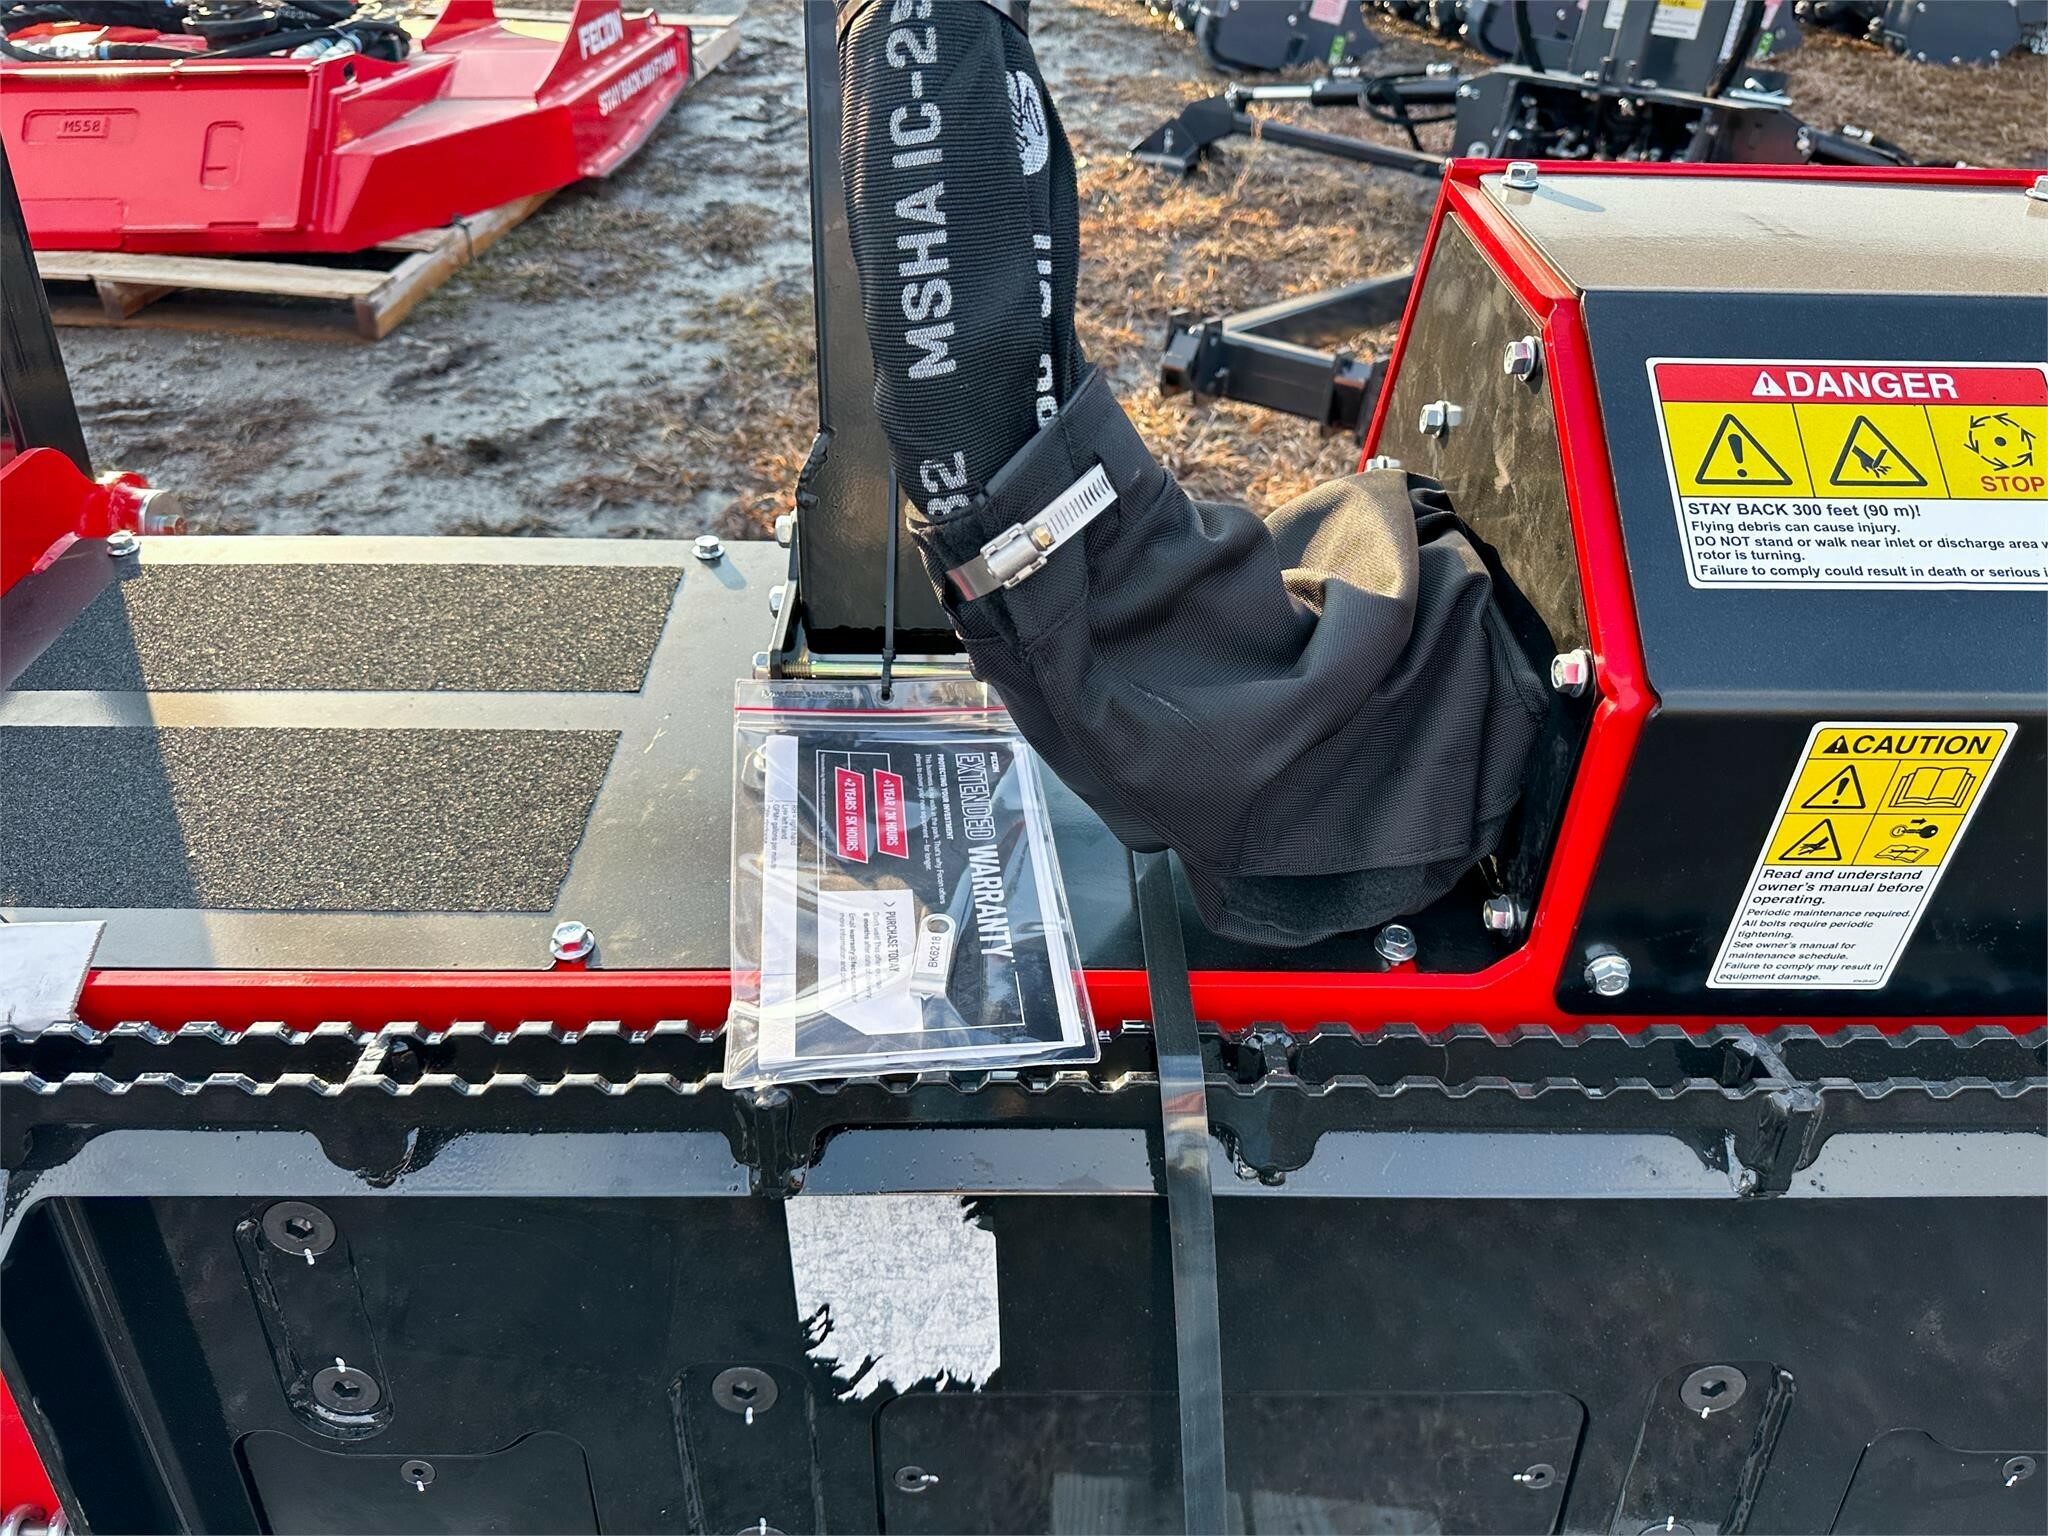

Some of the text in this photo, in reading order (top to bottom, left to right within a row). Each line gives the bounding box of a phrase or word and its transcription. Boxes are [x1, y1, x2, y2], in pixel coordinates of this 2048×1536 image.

[578, 9, 624, 60] FECON
[63, 119, 101, 133] M558
[895, 181, 957, 381] MSHA
[1785, 370, 1959, 399] DANGER
[1980, 475, 2045, 492] STOP
[1688, 502, 1921, 520] STAY BACK 300 feet (90 m)!
[1691, 520, 1901, 535] Flying debris can cause injury.
[1695, 535, 1716, 547] DO
[1721, 535, 1750, 547] NOT
[1755, 536, 1793, 547] stand
[1797, 539, 1812, 547] or
[1815, 536, 1847, 547] walk
[1851, 539, 1881, 548] near
[1884, 536, 1915, 549] inlet
[1919, 539, 1933, 549] or
[1937, 537, 2005, 551] discharge
[2009, 540, 2039, 549] area
[1697, 550, 1806, 563] rotor is turning.
[1701, 565, 1749, 576] Failure
[1752, 566, 1766, 576] to
[1769, 565, 1821, 579] comply
[1824, 566, 1863, 577] could
[1867, 566, 1907, 577] result
[1910, 566, 1924, 577] in
[1928, 566, 1966, 578] death
[1970, 568, 1985, 578] or
[1989, 566, 2041, 578] serious
[1852, 735, 1993, 755] CAUTION
[989, 751, 1000, 773] FECON
[844, 788, 857, 811] YEARS
[883, 787, 896, 806] YEAR
[954, 752, 997, 841] EXTENDED
[845, 815, 857, 826] 5K
[885, 811, 897, 822] 3K
[944, 804, 954, 840] INVESTMENT
[846, 826, 859, 851] HOURS
[886, 823, 898, 846] HOURS
[936, 870, 945, 887] Fecon
[1763, 869, 1923, 880] Read and understand
[1758, 882, 1924, 893] owner's manual before
[1752, 894, 1826, 906] operating.
[1747, 908, 1911, 919] Periodic maintenance required.
[885, 911, 898, 948] PURCHASE
[1742, 920, 1873, 930] All bolts require periodic
[1738, 930, 1794, 940] tightening.
[1733, 941, 1753, 949] See
[1755, 941, 1796, 949] owner's
[1728, 952, 1849, 960] maintenance schedule.
[1724, 962, 1760, 970] Failure
[1776, 962, 1814, 971] comply
[1817, 964, 1838, 972] may
[1720, 973, 1821, 982] equipment damage.
